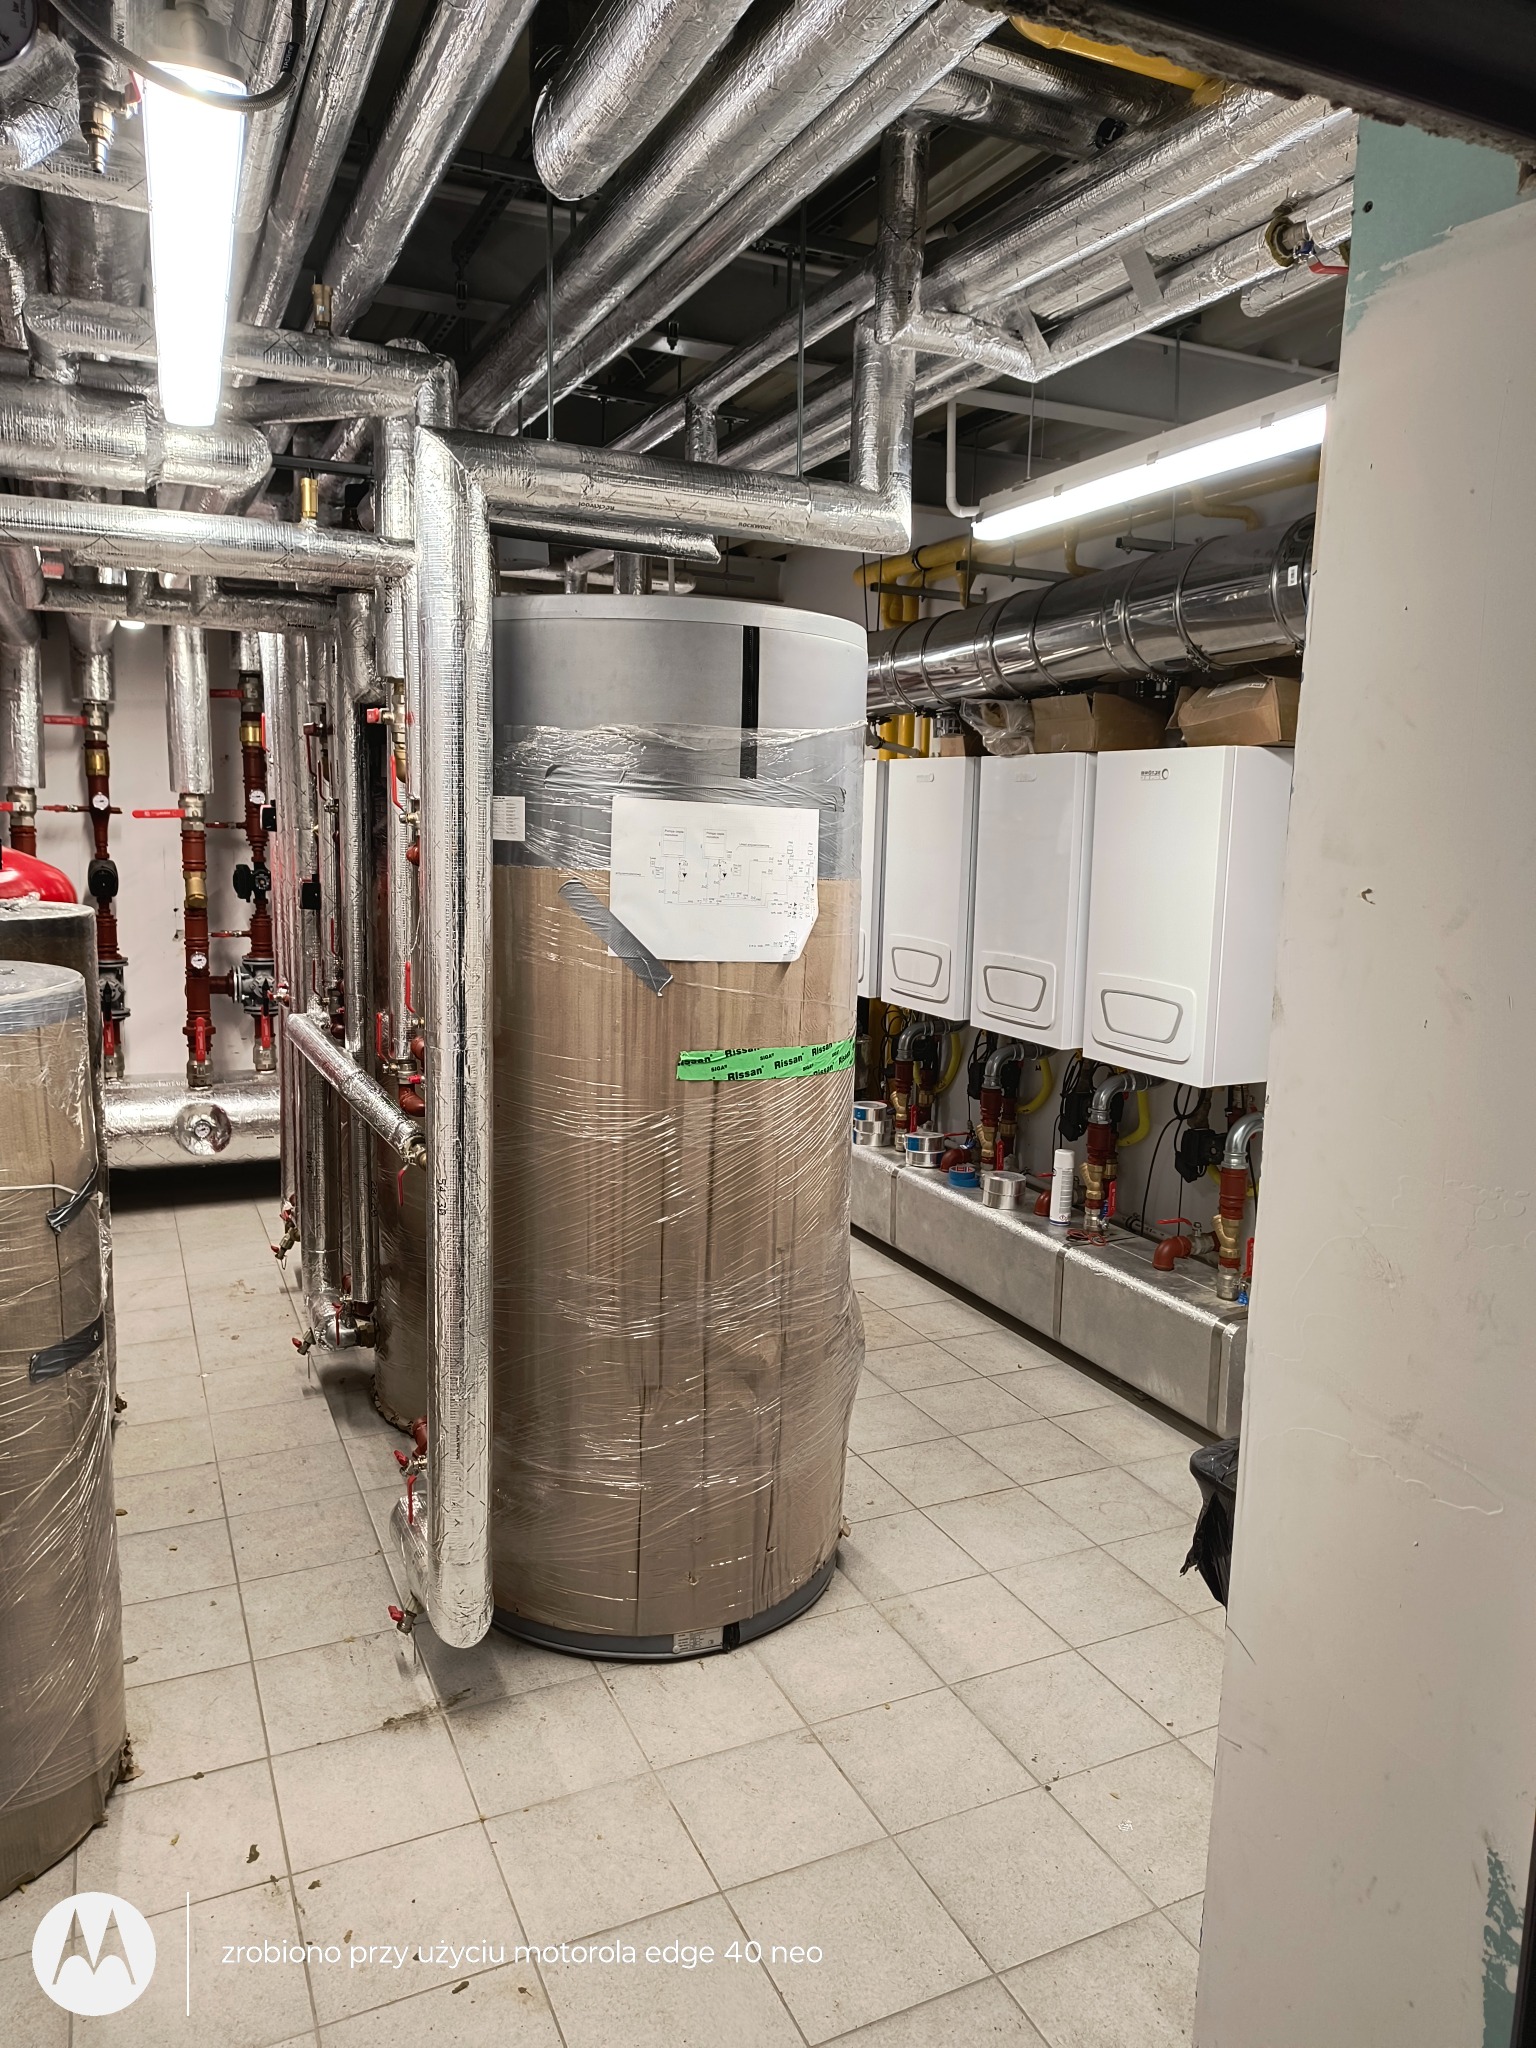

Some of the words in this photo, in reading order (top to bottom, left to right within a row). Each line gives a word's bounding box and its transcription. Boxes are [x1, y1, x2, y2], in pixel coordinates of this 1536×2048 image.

[738, 521, 771, 531] ROCKWOOL
[812, 1042, 833, 1057] Rissan
[774, 1053, 804, 1070] Rissan
[728, 1065, 765, 1081] Rissan
[437, 1178, 447, 1216] 54/30
